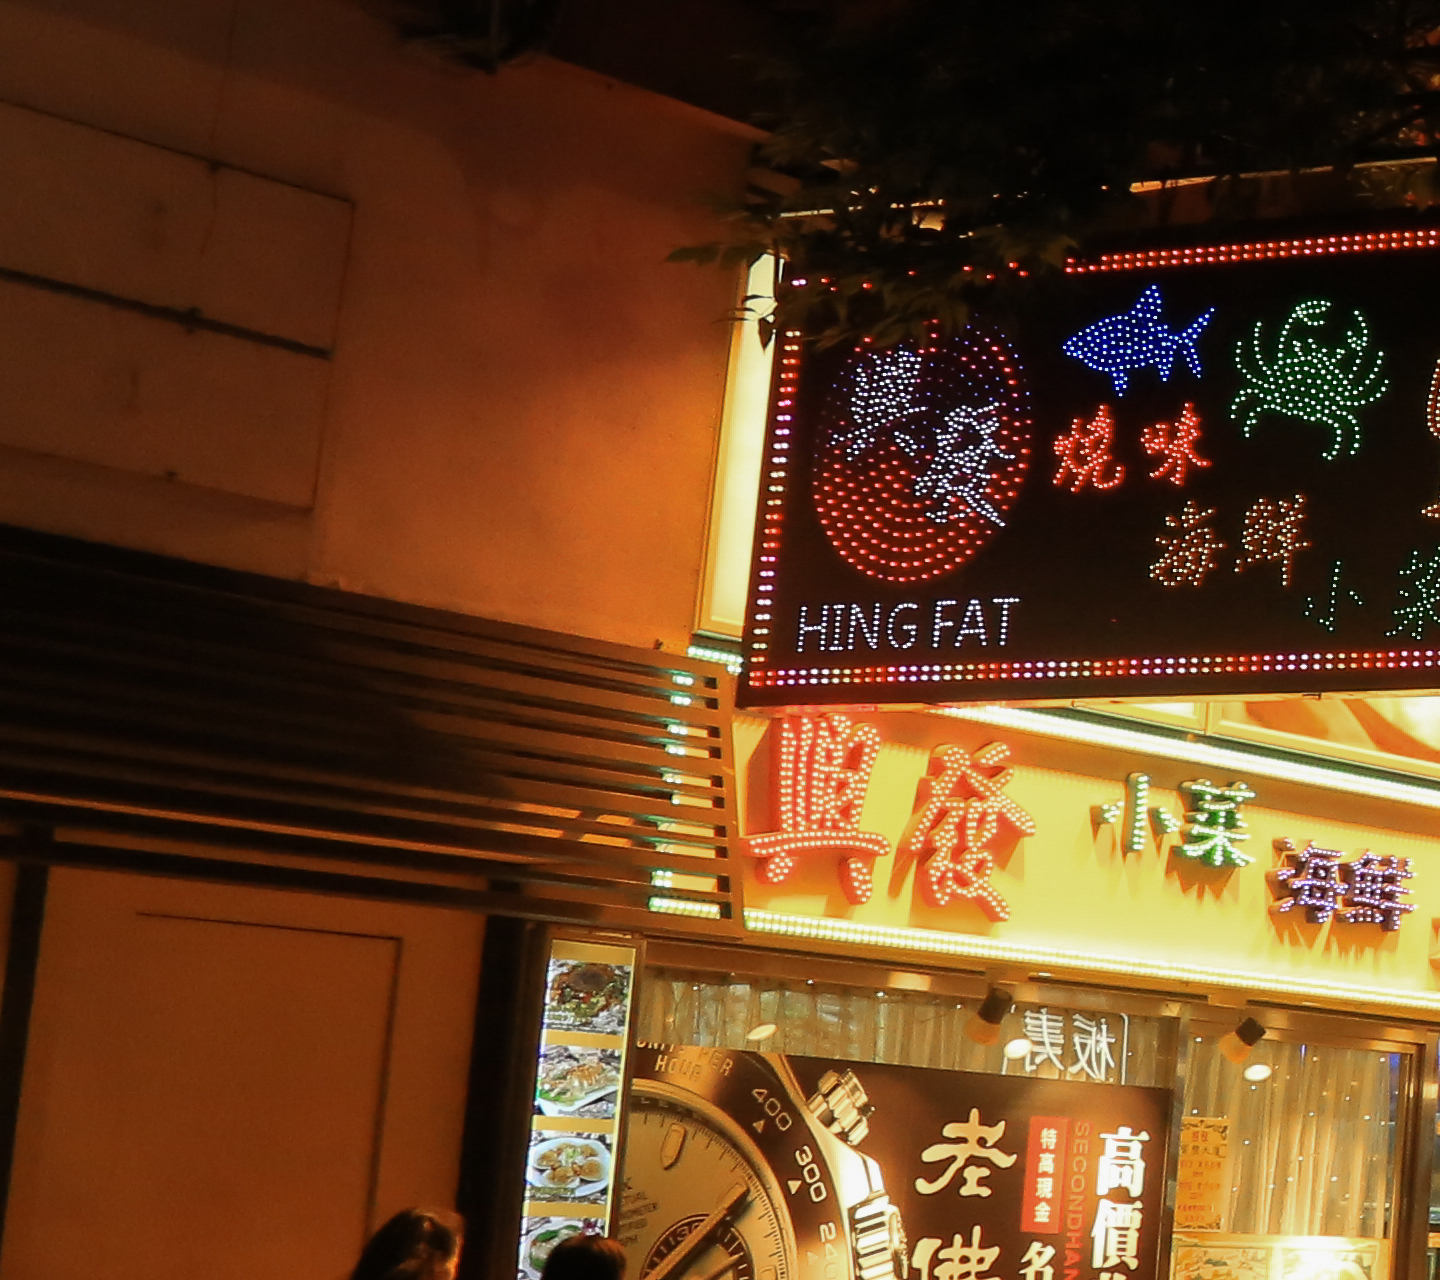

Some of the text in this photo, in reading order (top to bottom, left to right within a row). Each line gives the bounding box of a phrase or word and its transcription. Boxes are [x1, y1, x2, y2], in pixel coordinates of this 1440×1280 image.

[797, 594, 1021, 654] HING FAT
[1091, 771, 1257, 869] 小菜
[752, 1087, 793, 1132] 400
[794, 1144, 828, 1203] 300
[1033, 1128, 1058, 1224] 特高現金
